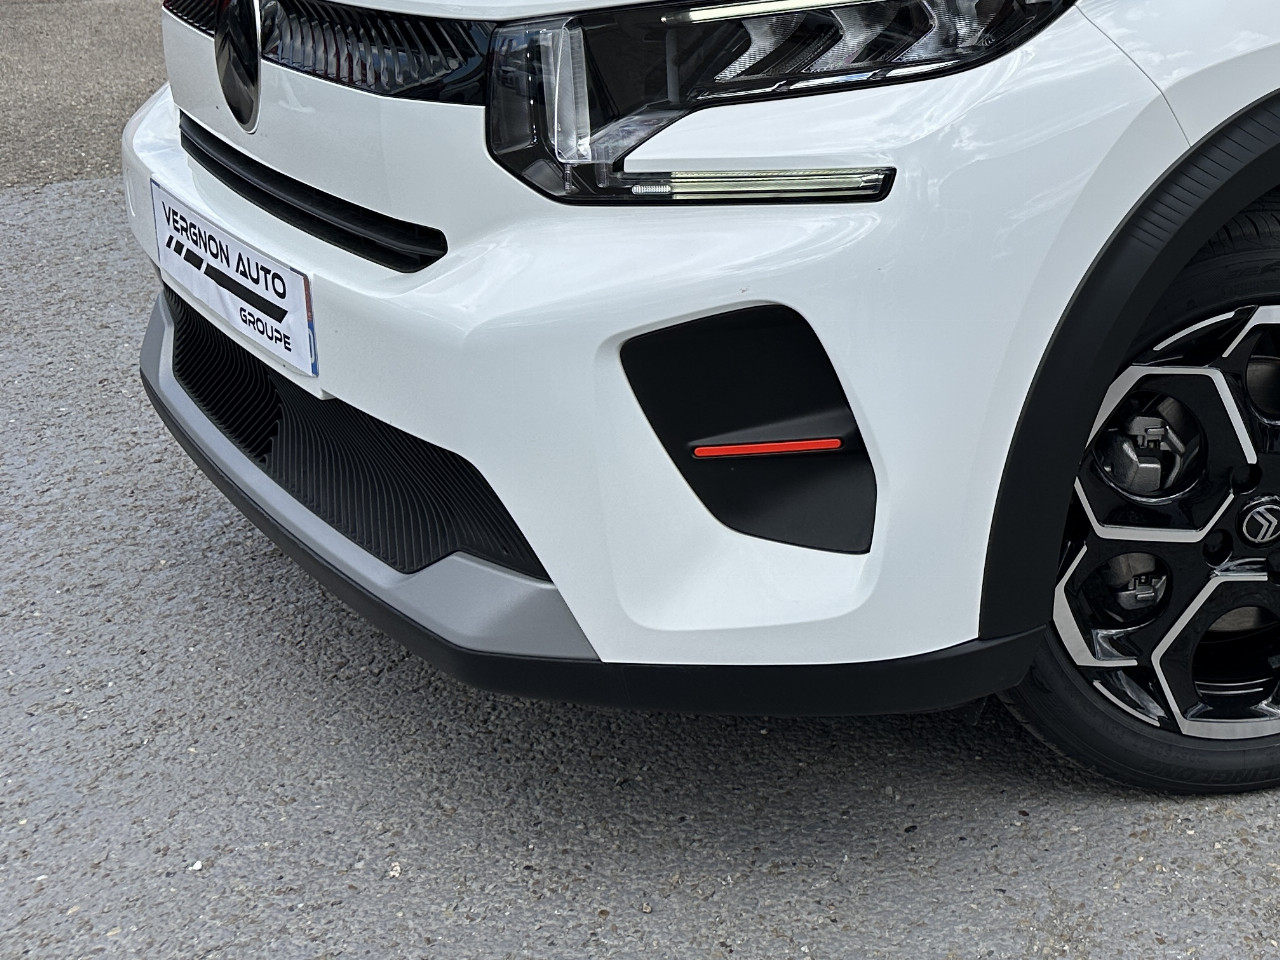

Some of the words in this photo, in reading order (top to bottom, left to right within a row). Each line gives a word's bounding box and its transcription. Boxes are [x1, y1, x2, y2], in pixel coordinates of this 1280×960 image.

[162, 201, 231, 268] VERGNON
[235, 251, 287, 300] AUTO
[239, 306, 293, 353] GROUPE
